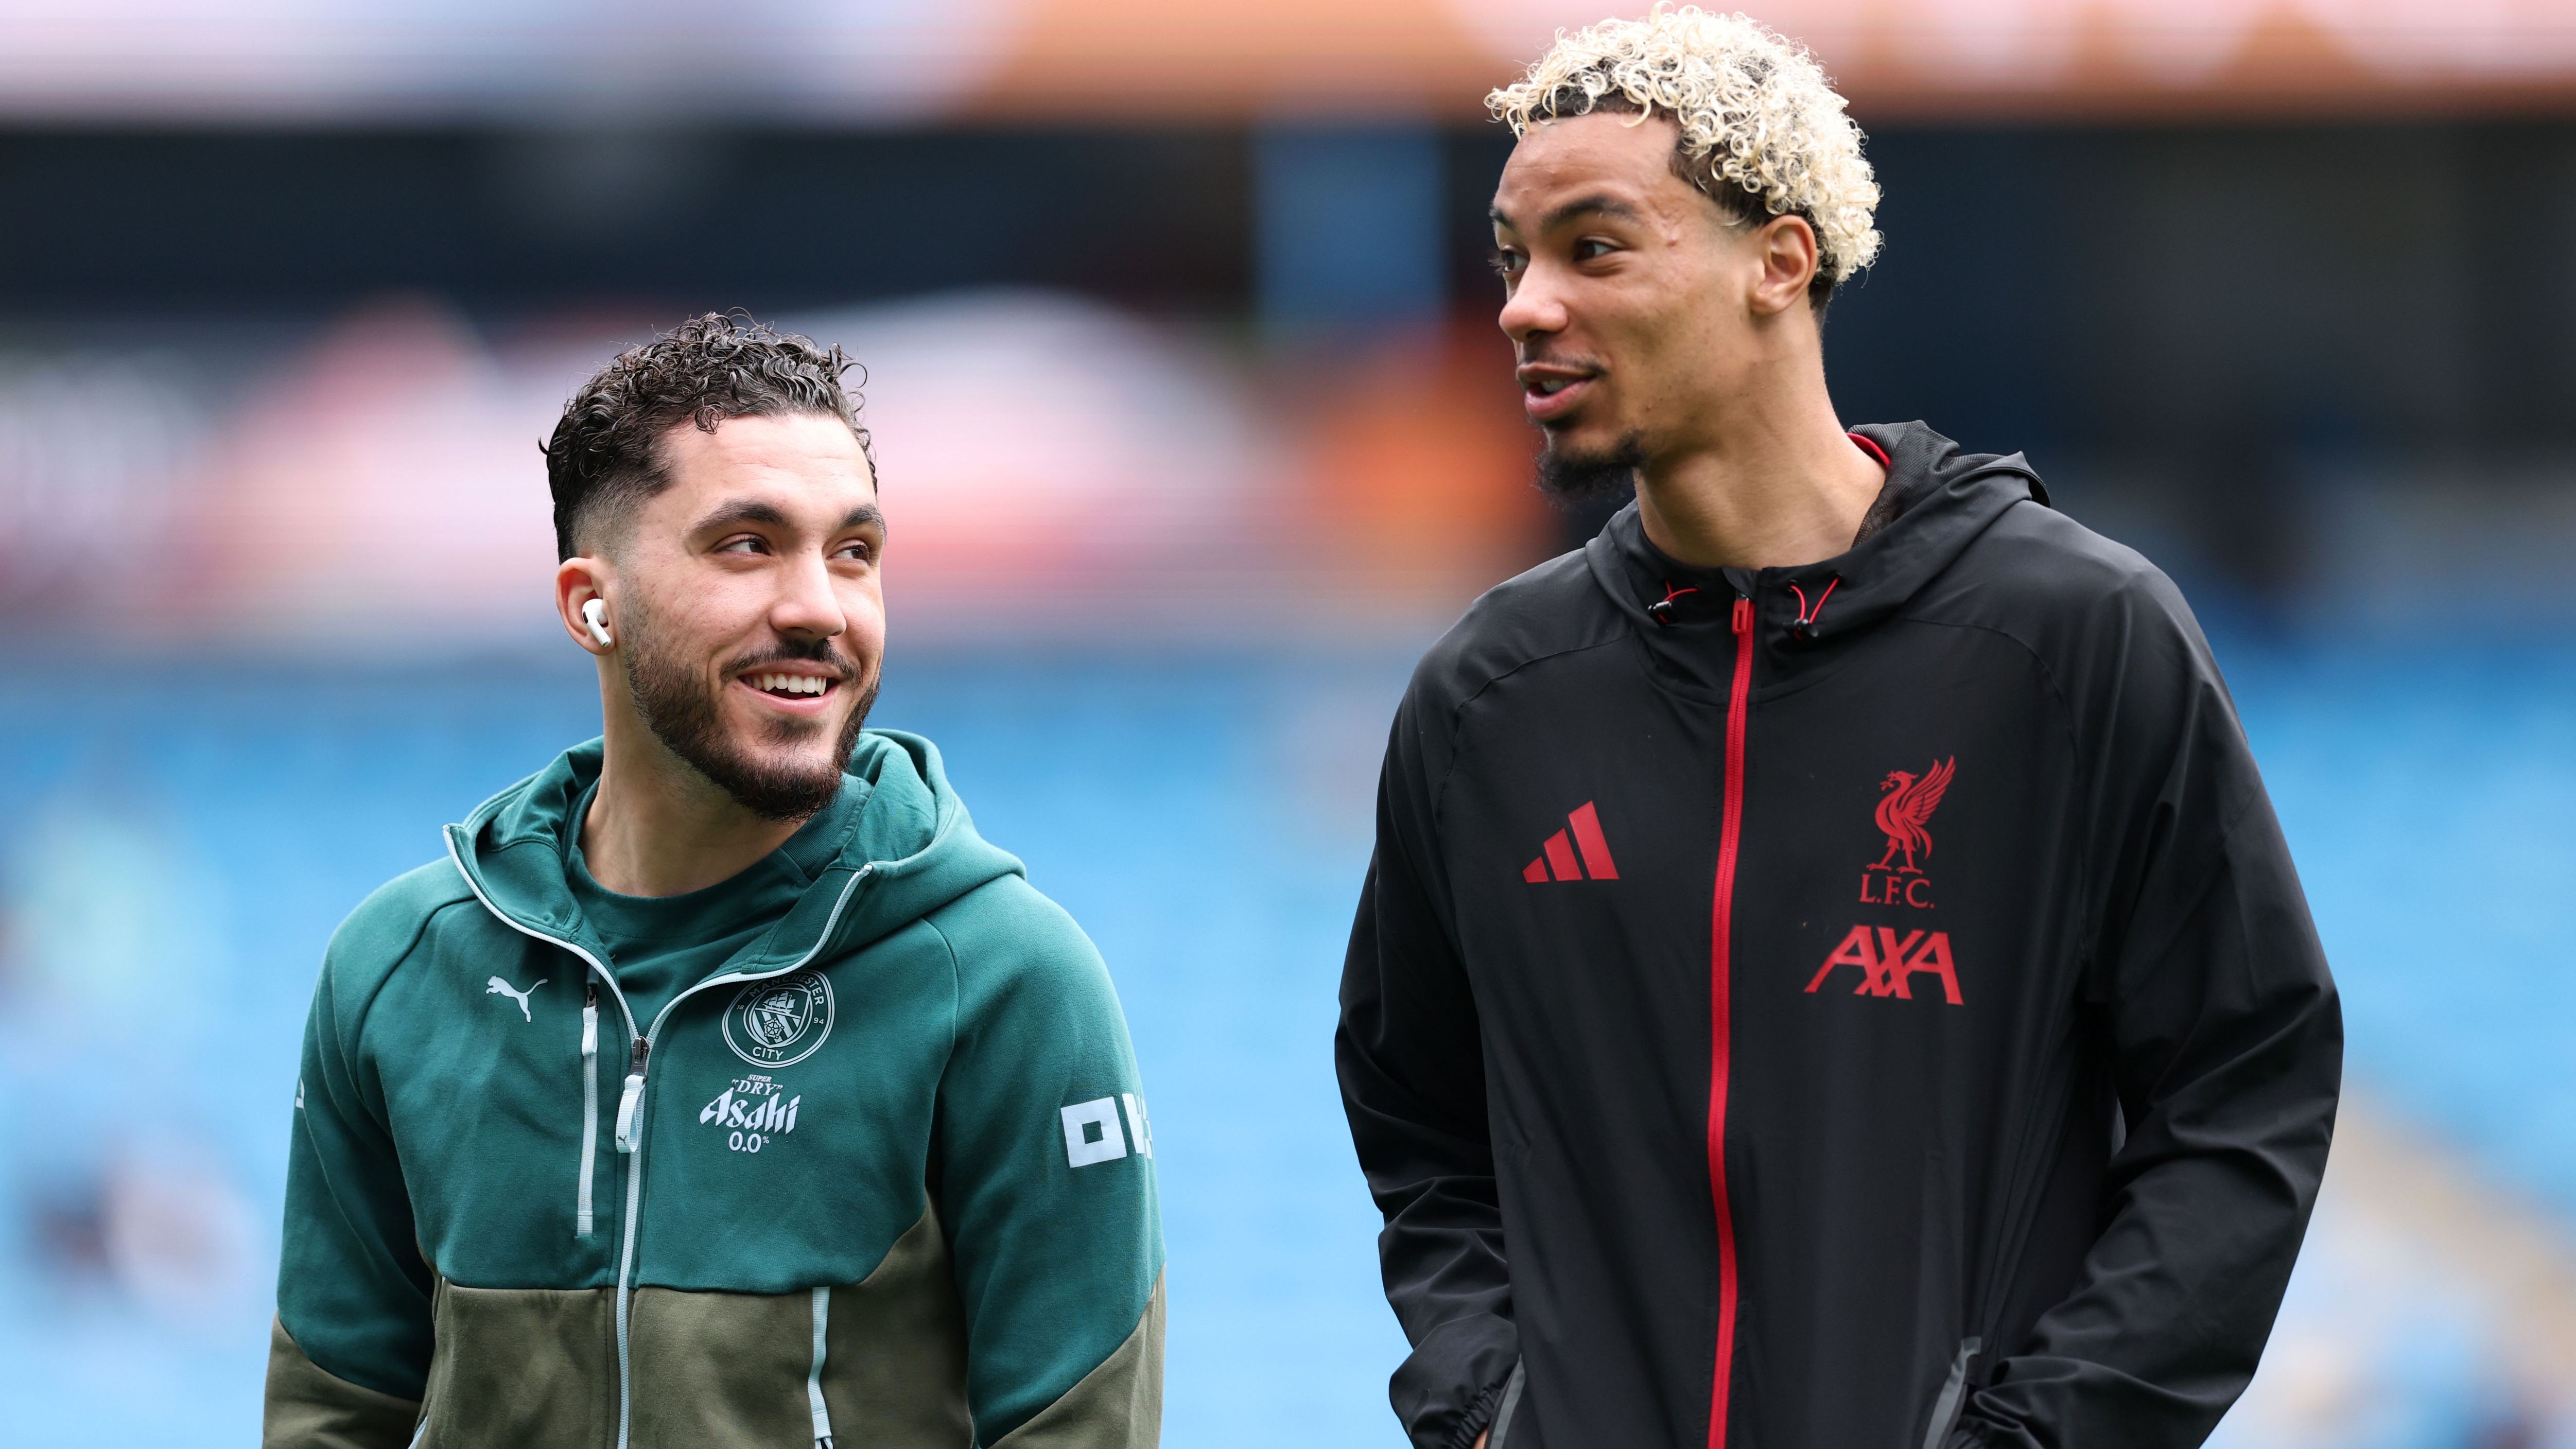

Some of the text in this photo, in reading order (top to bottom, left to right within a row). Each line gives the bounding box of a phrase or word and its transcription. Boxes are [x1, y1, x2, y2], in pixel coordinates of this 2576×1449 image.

[1803, 924, 1964, 1005] AXA
[749, 973, 824, 1006] MANCHESTER
[813, 1017, 824, 1025] 94
[752, 1046, 784, 1061] CITY
[747, 1074, 772, 1083] SUPER
[699, 1087, 802, 1135] Asahi
